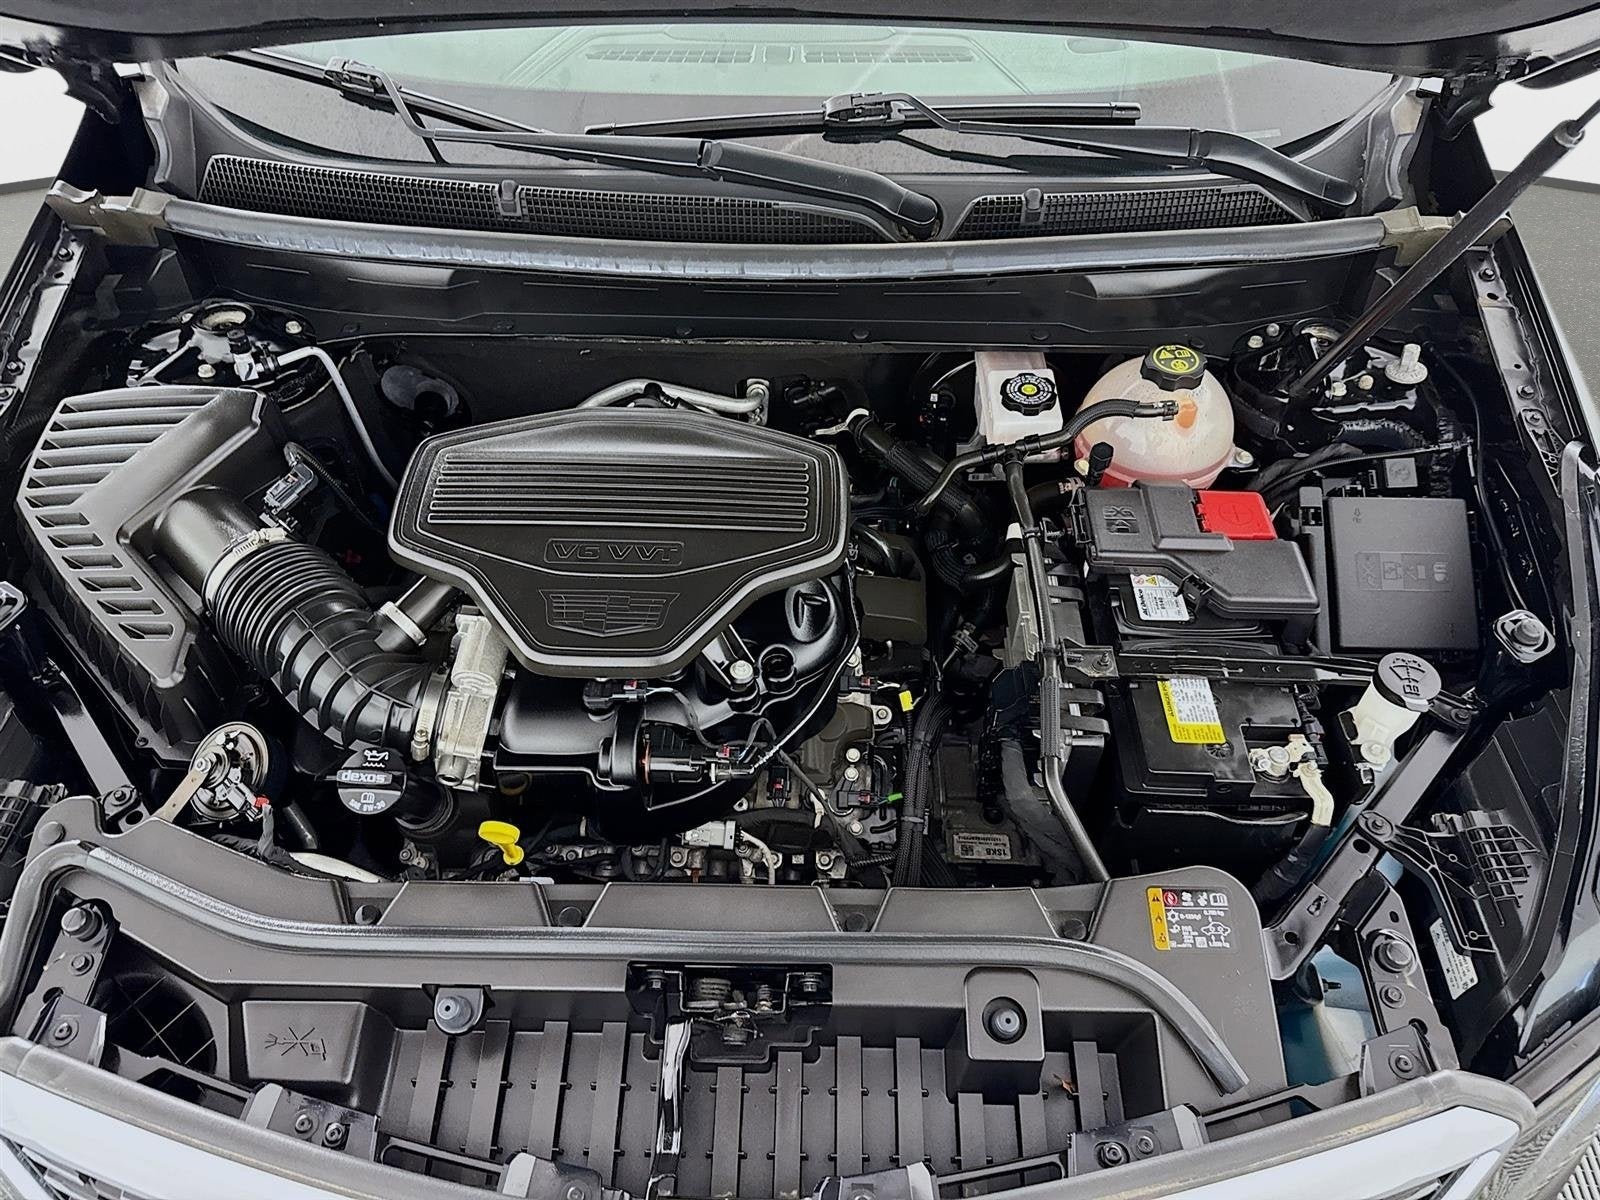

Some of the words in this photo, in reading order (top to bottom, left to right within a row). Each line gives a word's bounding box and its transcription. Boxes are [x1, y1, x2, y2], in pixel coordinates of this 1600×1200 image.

[552, 543, 600, 559] V6
[607, 544, 678, 561] VVT
[341, 769, 386, 784] dexos
